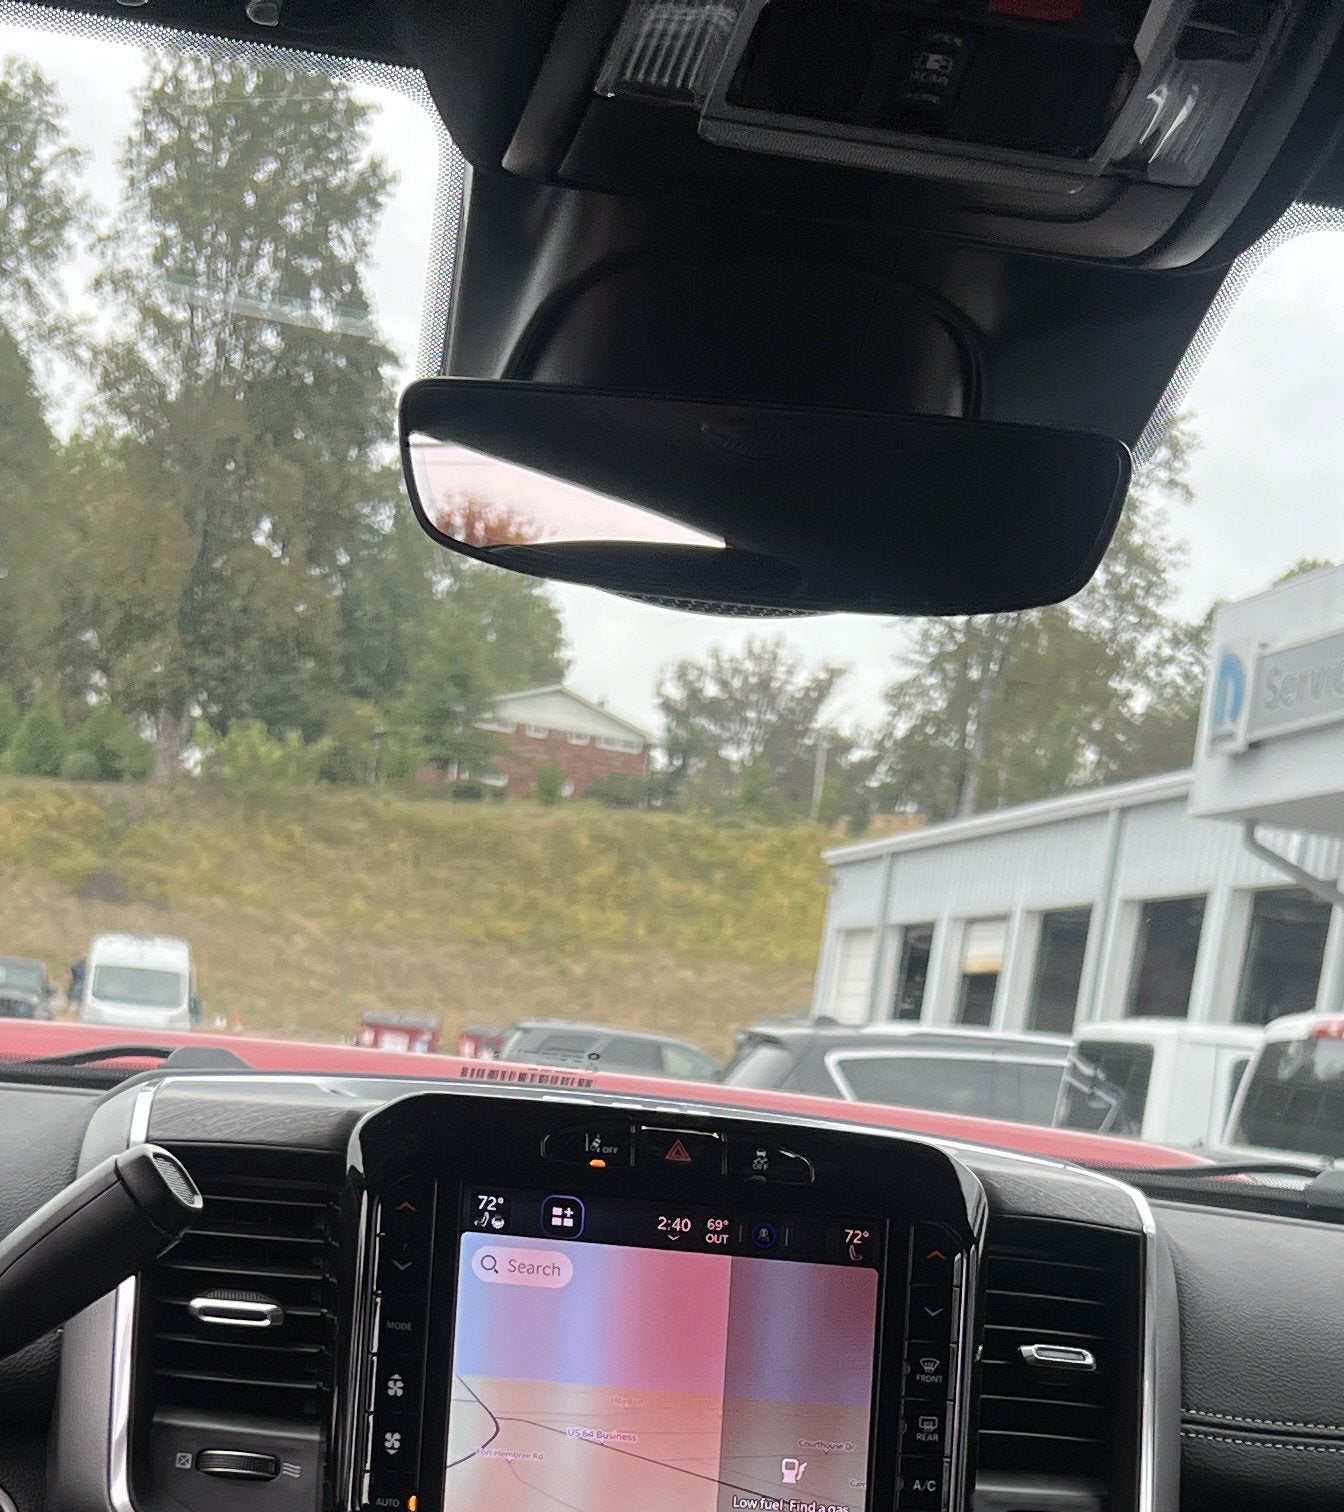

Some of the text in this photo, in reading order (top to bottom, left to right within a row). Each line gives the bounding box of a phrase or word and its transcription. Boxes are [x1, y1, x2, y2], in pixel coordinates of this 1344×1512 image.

[477, 1195, 505, 1211] 72°
[657, 1216, 692, 1233] 2:40
[707, 1218, 729, 1231] 69°
[705, 1233, 729, 1244] OUT
[844, 1228, 870, 1244] 72°
[507, 1258, 561, 1277] Search
[567, 1428, 580, 1437] US
[596, 1431, 637, 1442] Business
[916, 1432, 939, 1441] REAR
[798, 1440, 855, 1451] Courthouse Dr
[532, 1452, 544, 1461] Rd
[913, 1480, 937, 1492] A/C
[375, 1497, 400, 1507] AUTO
[733, 1496, 757, 1508] Low
